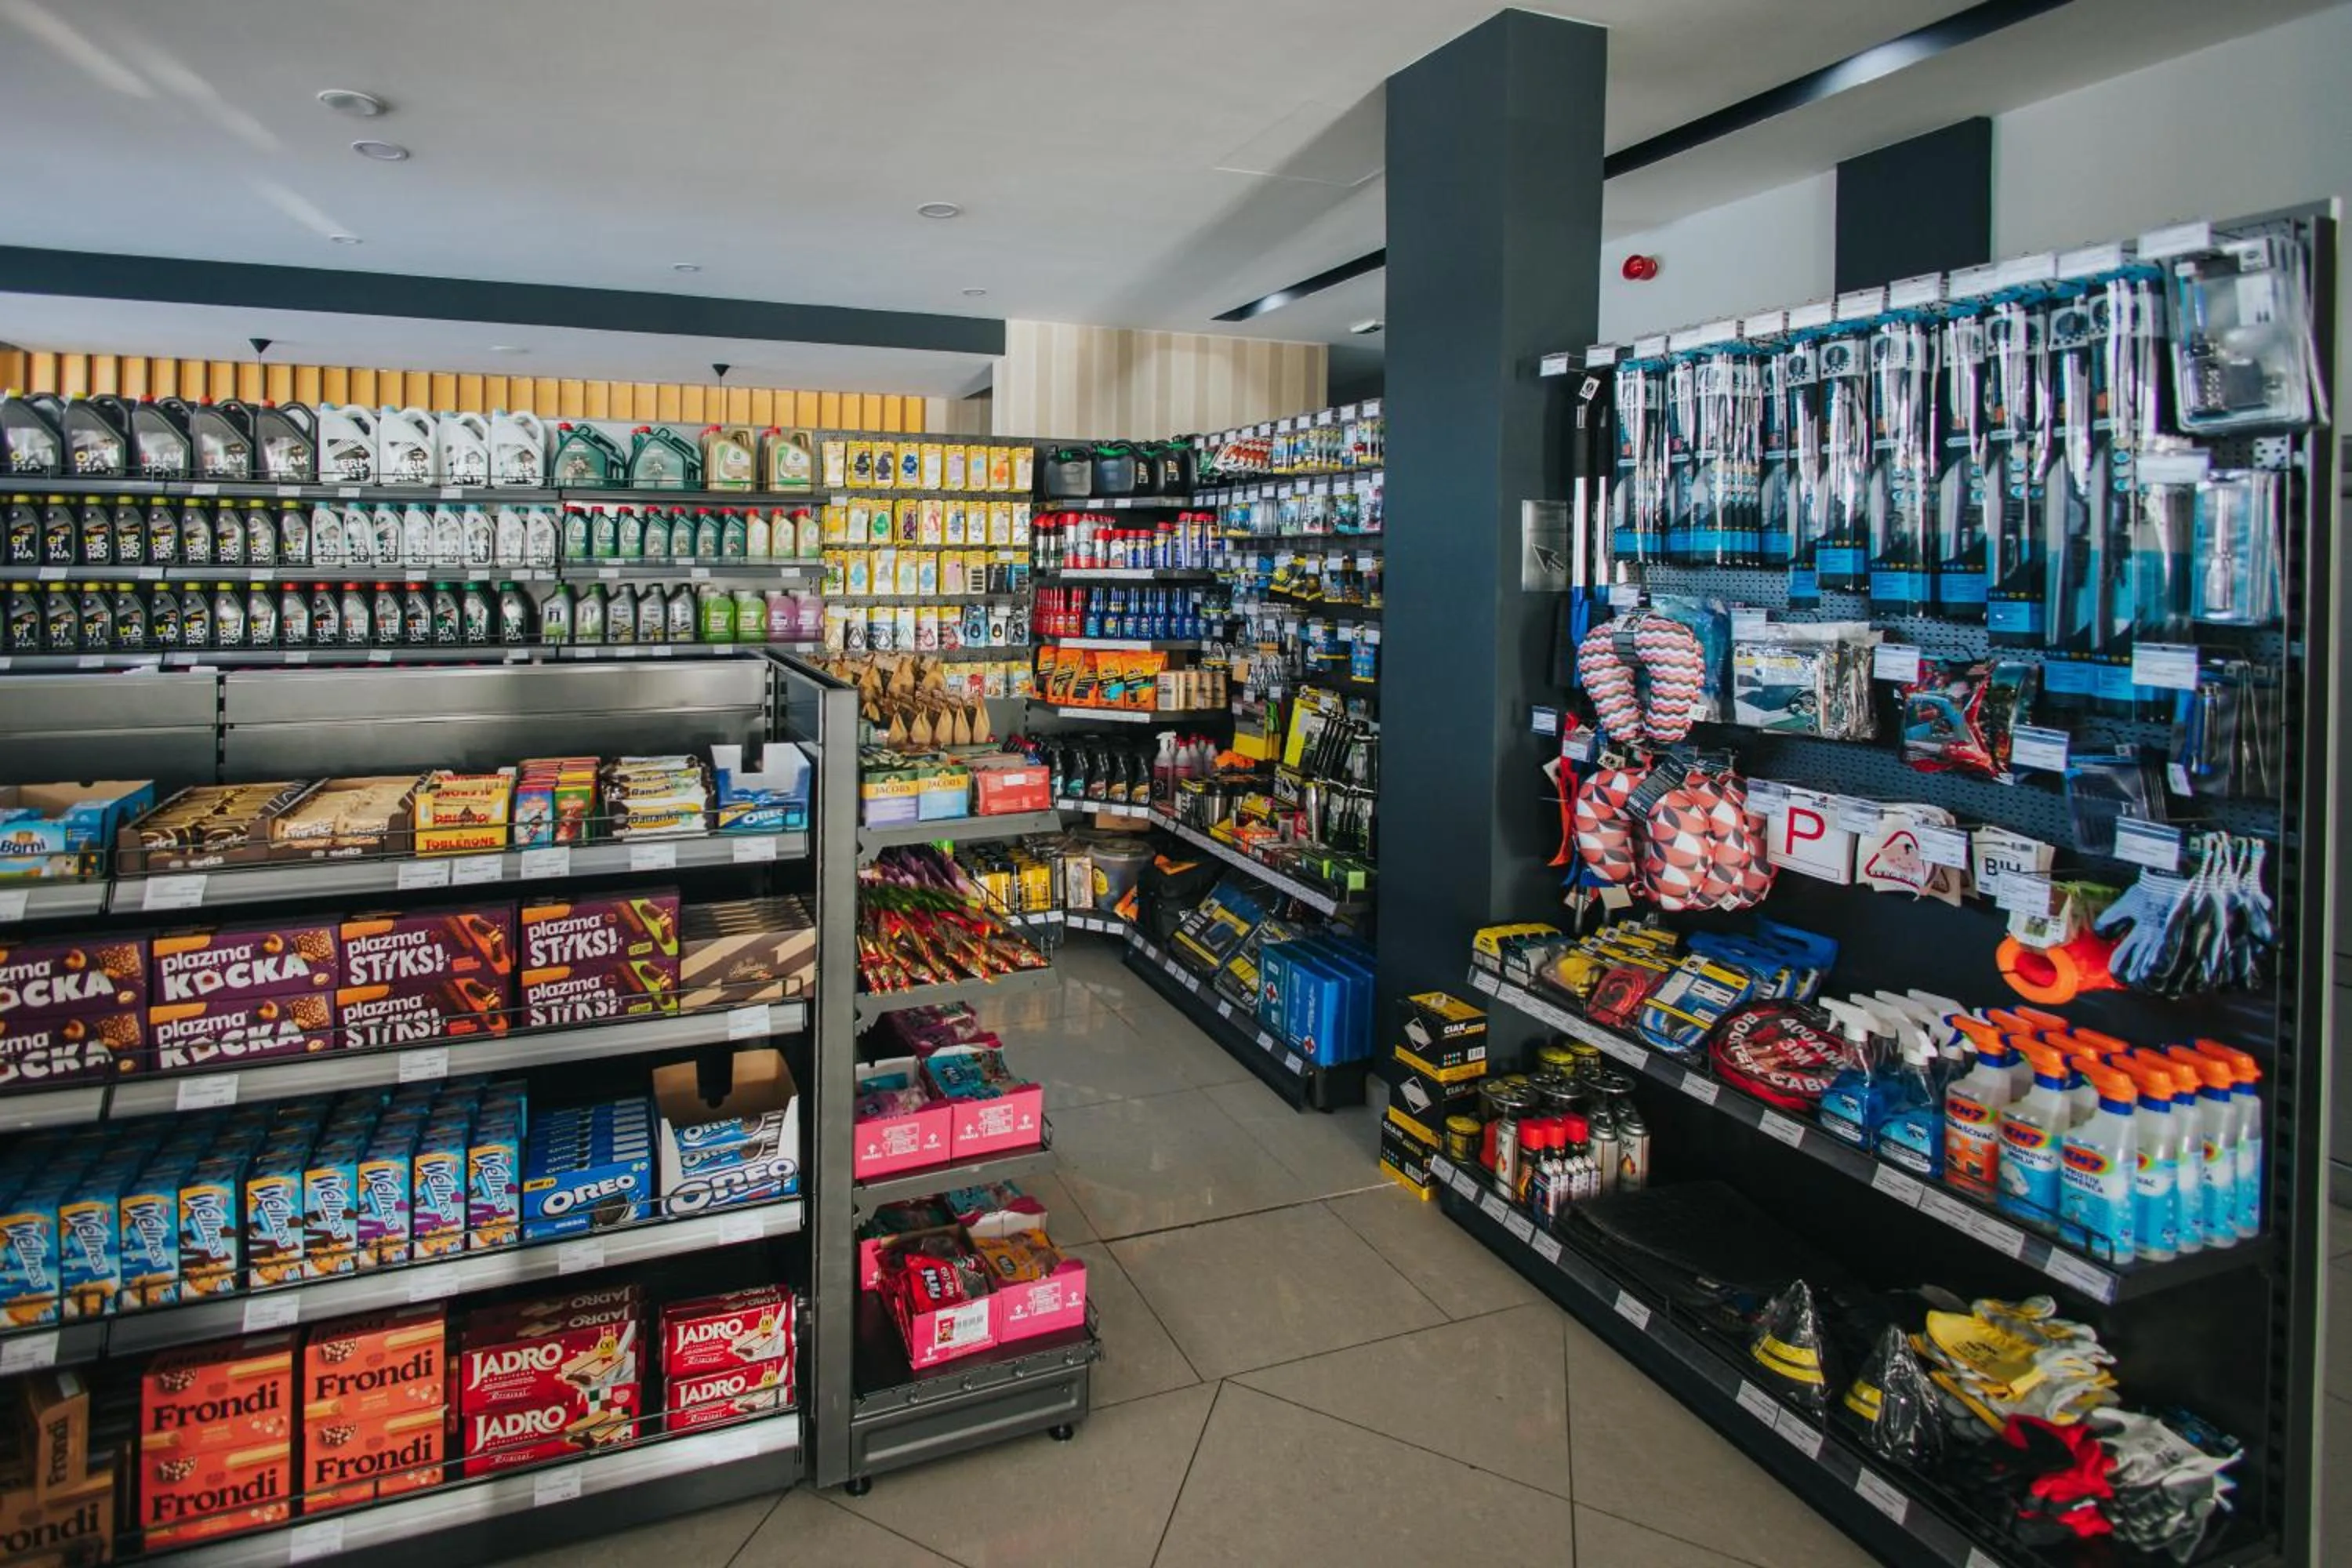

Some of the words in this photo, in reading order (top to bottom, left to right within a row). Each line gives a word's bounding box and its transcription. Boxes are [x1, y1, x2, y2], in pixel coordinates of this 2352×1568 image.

[875, 785, 910, 794] JACOBS
[1, 839, 45, 854] Barni
[425, 837, 497, 851] TOBLERONE
[1785, 806, 1826, 855] P
[347, 931, 426, 959] plazma
[528, 914, 601, 942] plazma
[162, 945, 252, 977] plazma
[163, 953, 310, 1002] KOCKA
[343, 995, 423, 1024] plazma
[528, 976, 601, 1004] plazma
[158, 1011, 247, 1044] plazma
[159, 1021, 305, 1069] KOCKA
[1443, 1022, 1466, 1034] CIAK
[365, 1168, 401, 1228] Wellness
[420, 1160, 455, 1220] Wellness
[476, 1152, 510, 1211] Wellness
[542, 1174, 637, 1215] OREO
[669, 1158, 797, 1215] OREO
[186, 1193, 226, 1256] Wellness
[253, 1184, 292, 1247] Wellness
[310, 1176, 348, 1238] Wellness
[5, 1221, 48, 1286] Wellness
[64, 1209, 108, 1273] Wellness
[127, 1202, 169, 1265] Wellness
[569, 1305, 630, 1327] JADRO
[673, 1318, 743, 1355] JADRO
[315, 1349, 434, 1400] Frondi
[467, 1342, 563, 1391] JADRO
[152, 1381, 280, 1432] Frondi
[680, 1376, 746, 1407] JADRO
[471, 1405, 566, 1453] JADRO
[315, 1433, 434, 1484] Frondi
[151, 1468, 278, 1521] Frondi
